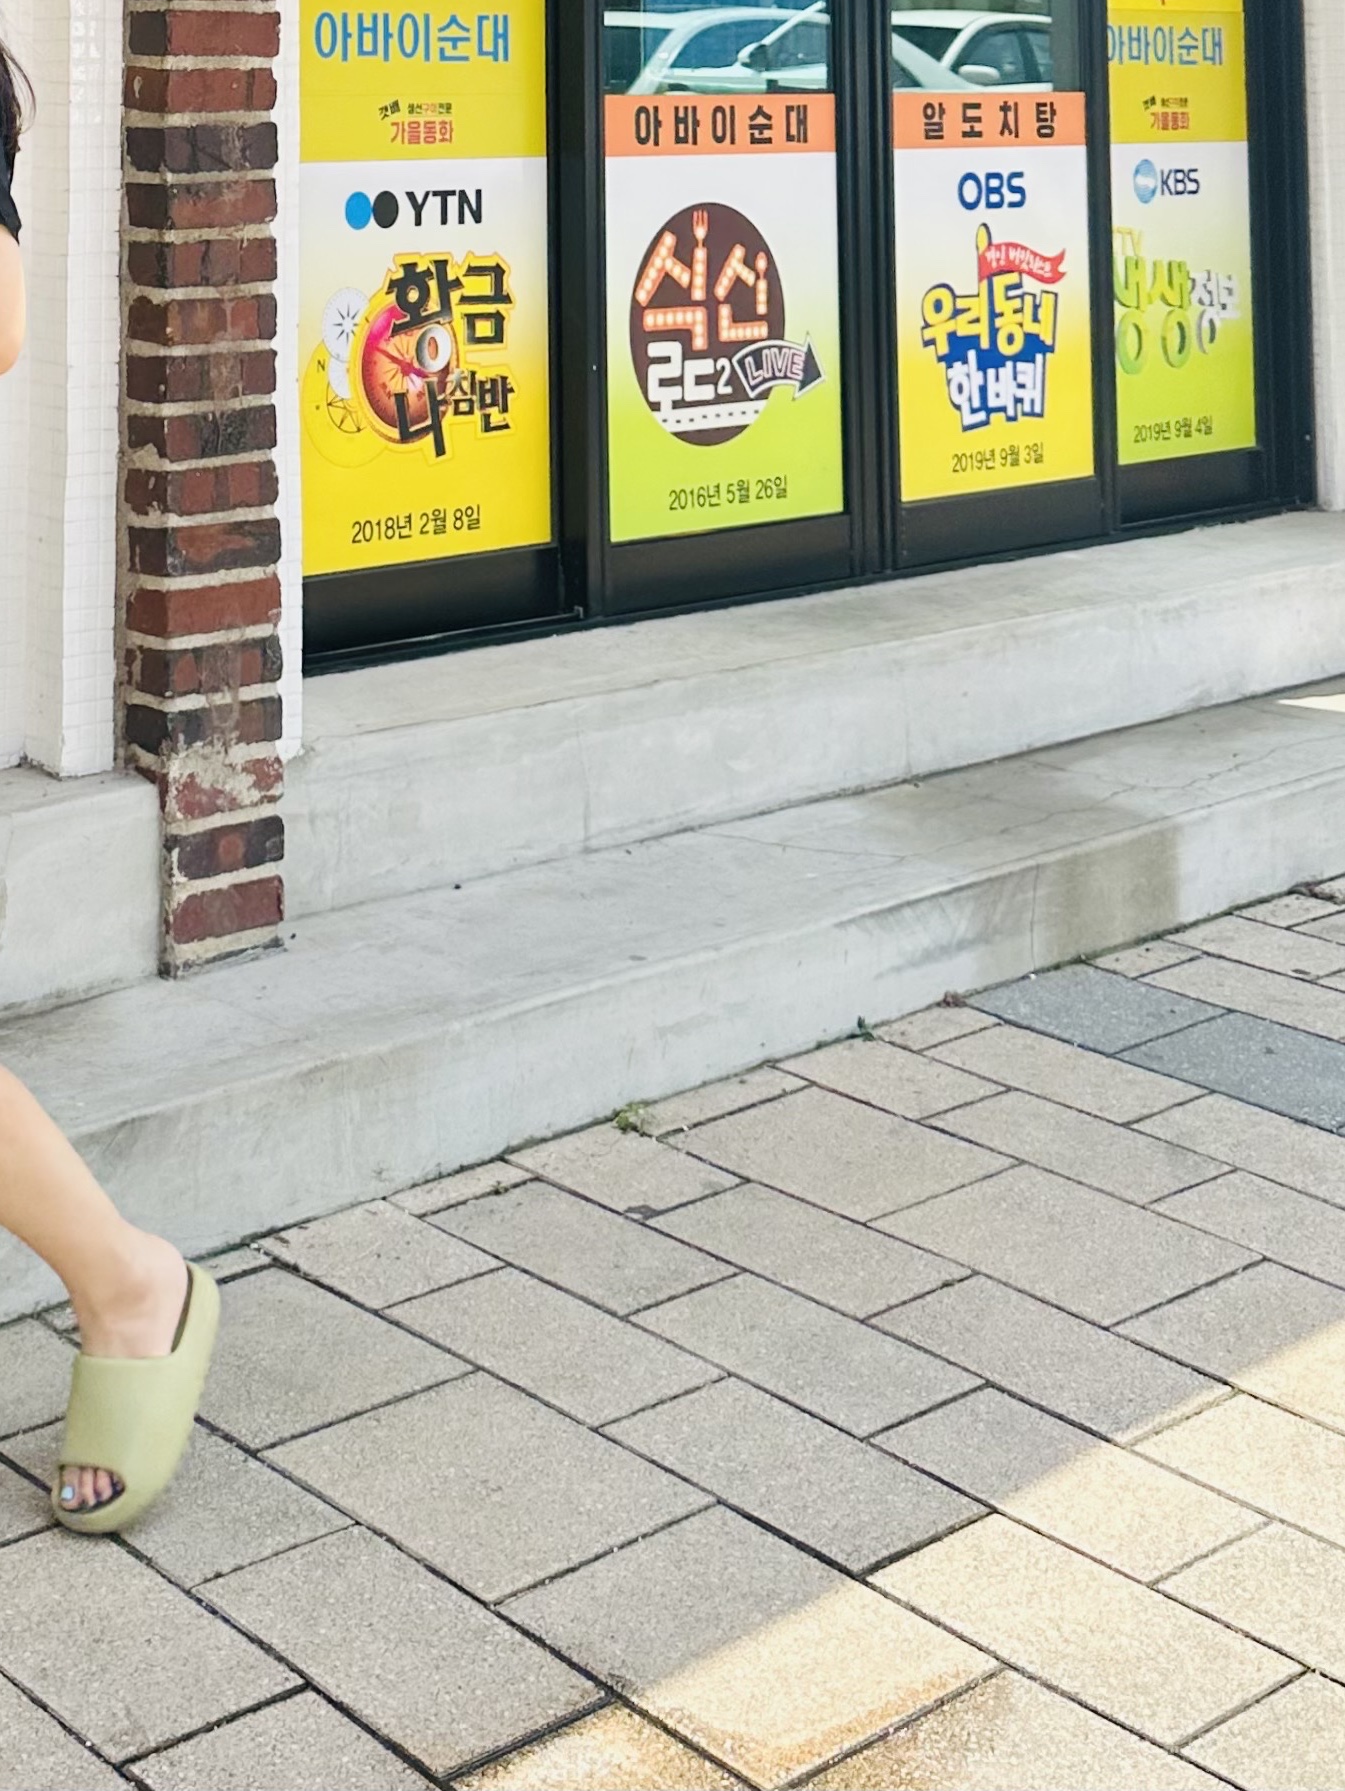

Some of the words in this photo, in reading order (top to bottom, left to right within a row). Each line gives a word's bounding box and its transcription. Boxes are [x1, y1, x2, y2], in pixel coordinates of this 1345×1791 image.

[314, 11, 511, 65] 아바이순대
[390, 119, 454, 145] 가을동화
[957, 171, 1027, 211] OBS
[1160, 168, 1200, 197] KBS
[405, 188, 484, 227] YTN
[921, 272, 1059, 358] 우리동네
[743, 345, 807, 387] LIVE
[1133, 422, 1172, 444] 2019년
[1174, 419, 1193, 440] 9월
[1195, 414, 1214, 437] 4일
[951, 448, 997, 475] 2019년
[999, 444, 1021, 468] 9월
[1024, 441, 1045, 465] 3일
[668, 482, 722, 512] 2016년
[726, 479, 751, 505] 5월
[755, 474, 789, 501] 26일
[351, 512, 414, 544] 2018년
[419, 508, 449, 538] 2월
[453, 504, 482, 533] 8일
